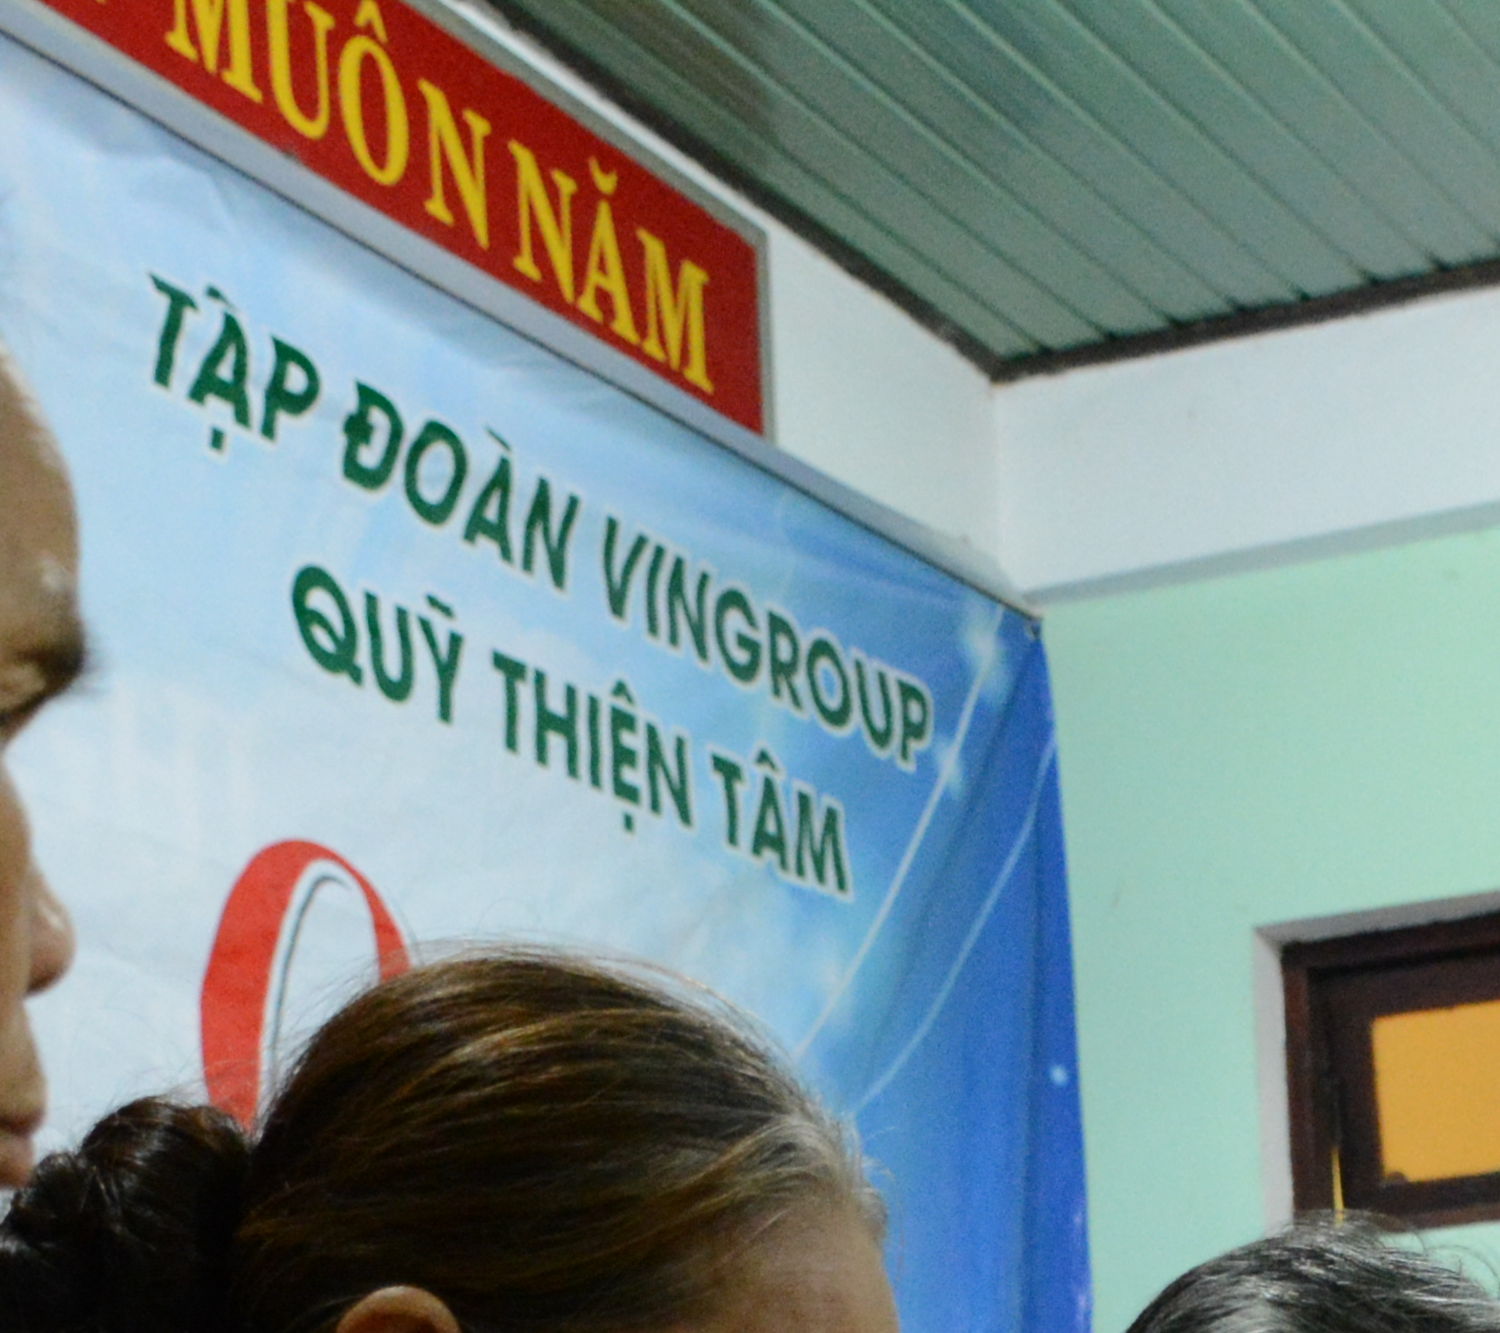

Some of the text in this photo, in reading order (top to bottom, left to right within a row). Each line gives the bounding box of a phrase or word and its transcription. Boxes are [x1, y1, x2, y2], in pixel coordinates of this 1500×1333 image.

[510, 138, 714, 396] NĂM
[148, 270, 934, 770] TẬP ĐOÀN VINGROUP
[290, 564, 849, 895] QUỸ THIỆN TÂM
